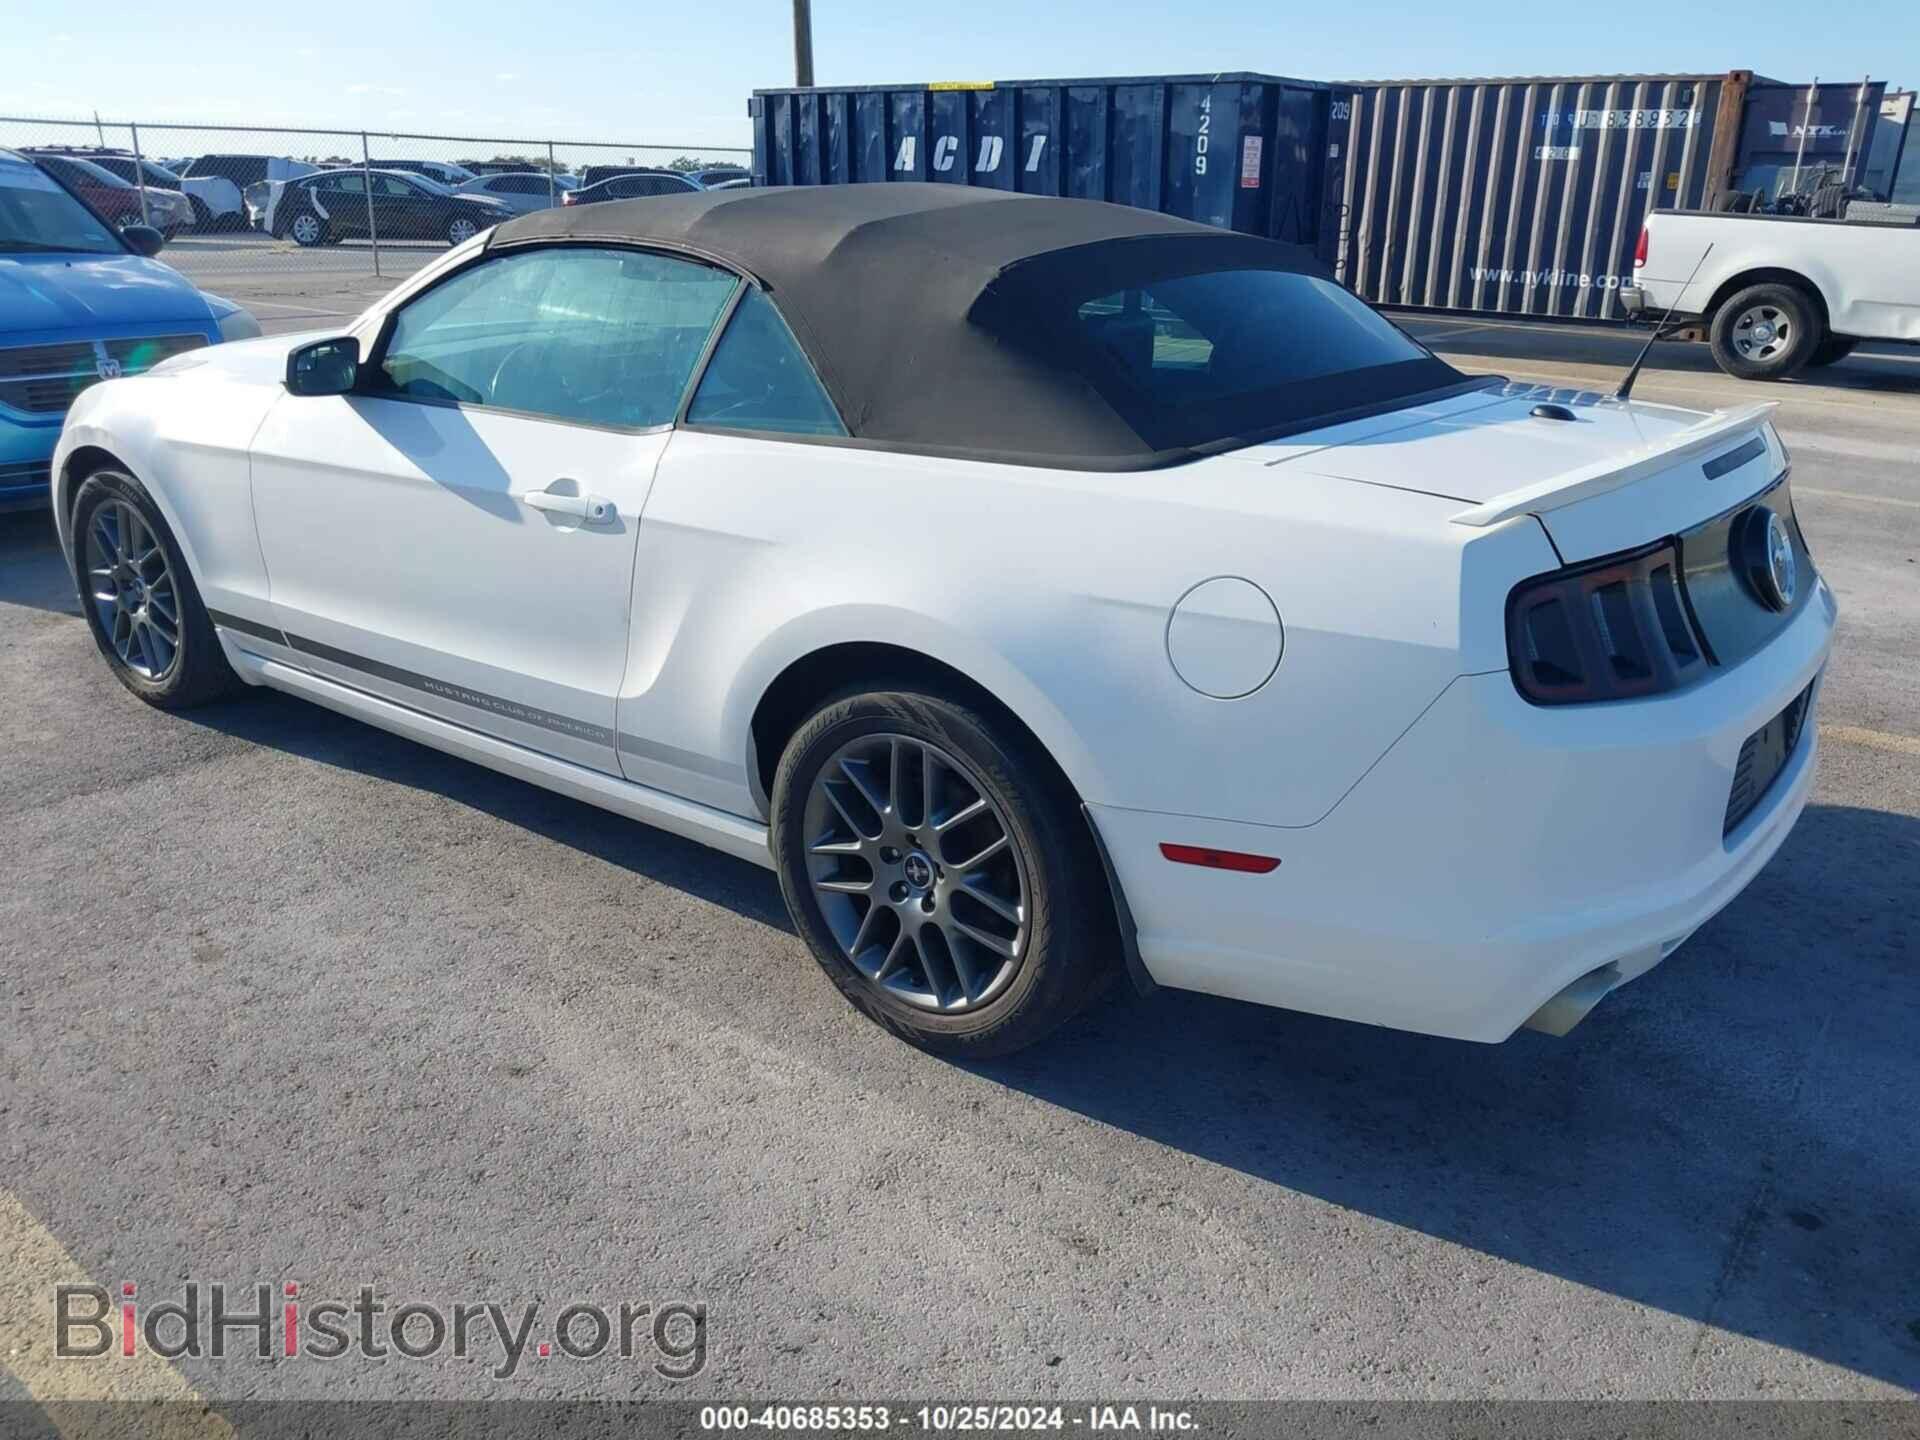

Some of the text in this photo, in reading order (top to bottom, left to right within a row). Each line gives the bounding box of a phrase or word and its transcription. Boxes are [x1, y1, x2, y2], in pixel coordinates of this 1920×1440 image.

[1195, 95, 1211, 174] 4209
[894, 136, 1047, 171] ACDI
[424, 681, 492, 706] MUSTANG
[493, 702, 525, 716] CLUB
